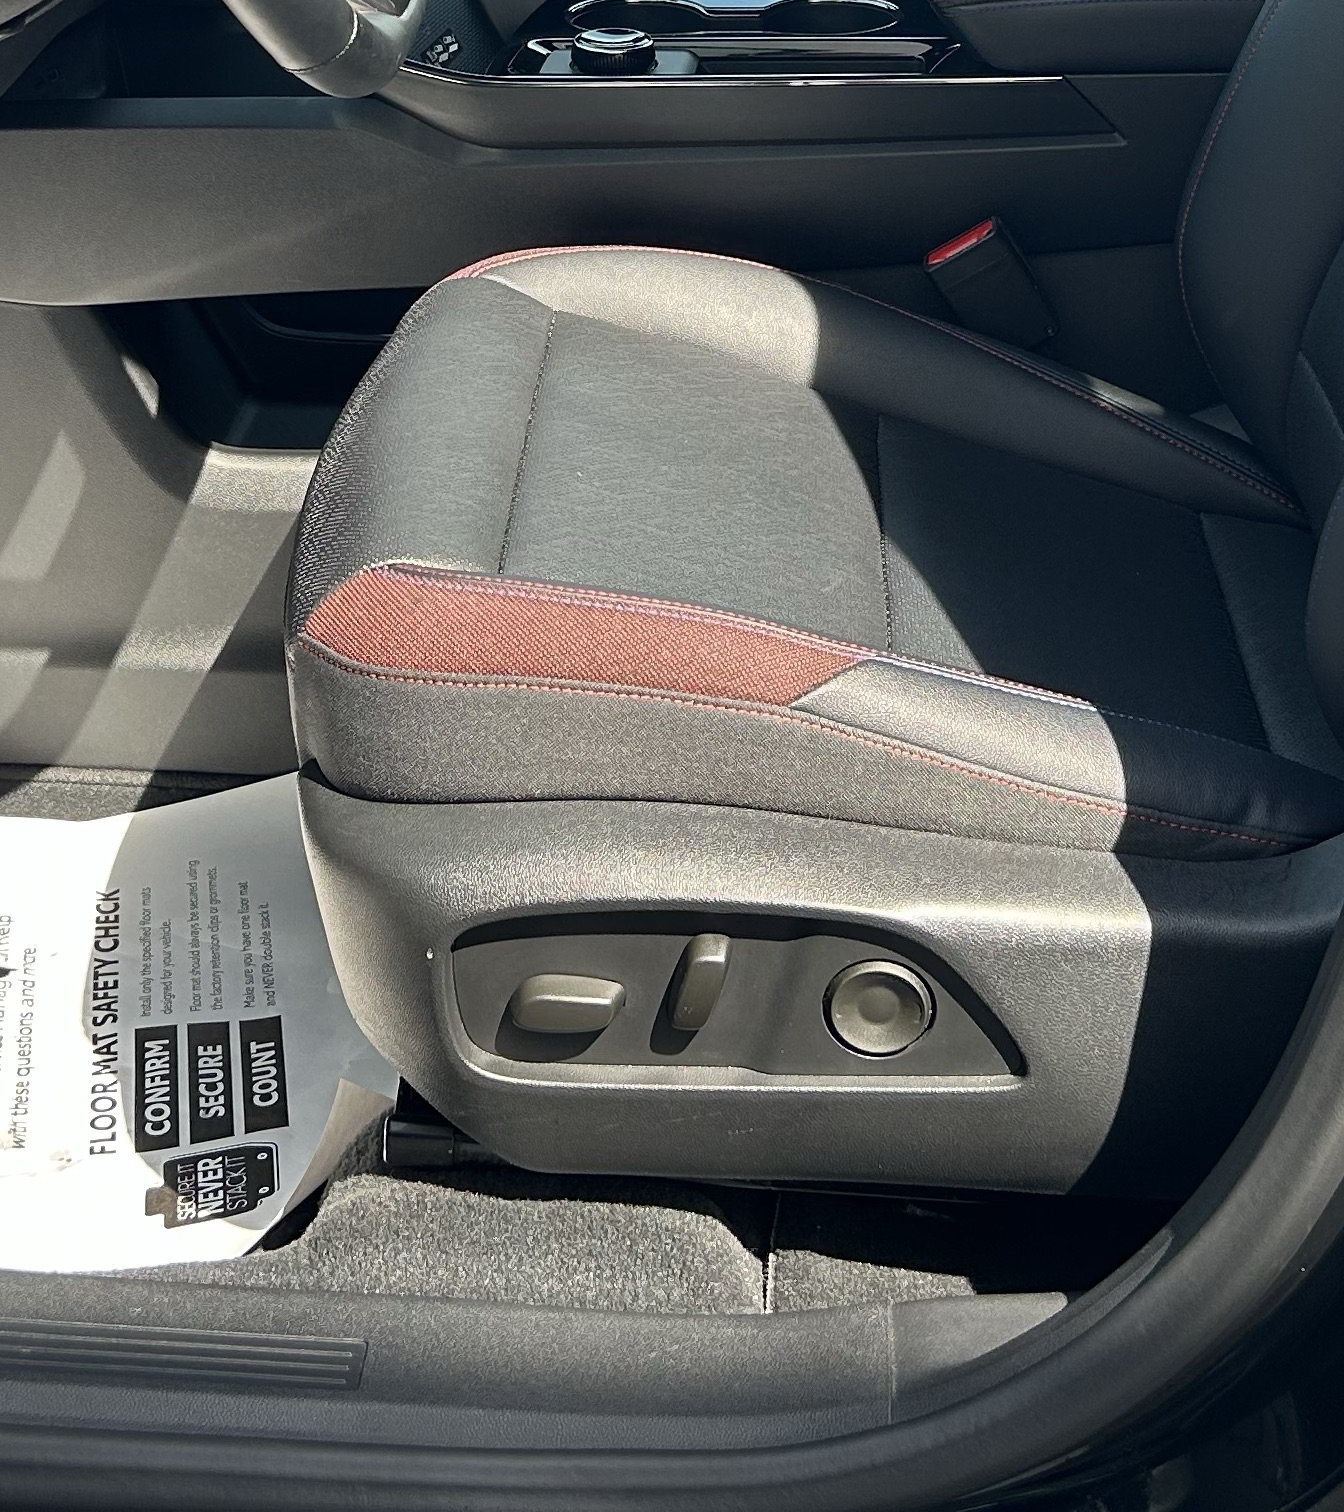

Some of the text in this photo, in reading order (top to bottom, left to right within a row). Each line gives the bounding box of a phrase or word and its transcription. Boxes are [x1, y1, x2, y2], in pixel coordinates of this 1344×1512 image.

[186, 882, 199, 909] secured
[186, 910, 199, 921] be
[207, 914, 221, 931] clips
[240, 914, 251, 929] one
[258, 909, 270, 929] stack
[140, 926, 154, 962] specified
[208, 933, 222, 968] retention
[239, 930, 252, 951] have
[259, 930, 273, 960] double
[140, 963, 152, 975] the
[160, 918, 175, 1014] designed for your vehicle.
[188, 950, 201, 976] should
[242, 952, 257, 967] you
[190, 977, 201, 990] mat
[209, 969, 225, 995] factory
[242, 968, 254, 984] sure
[261, 962, 275, 988] NEVER
[15, 977, 38, 1008] and
[139, 994, 152, 1016] Install
[189, 992, 202, 1011] Floor
[210, 996, 223, 1010] the
[242, 985, 256, 1007] Make
[263, 990, 276, 1006] and
[89, 887, 120, 1155] FLOOR MAT SAFETY CHECK
[9, 1010, 41, 1078] questions
[197, 1043, 225, 1118] SECURE
[250, 1040, 279, 1107] COUNT
[8, 1079, 32, 1116] these
[143, 1038, 172, 1136] CONFIRM
[173, 1162, 199, 1220] SECURE IT
[192, 1155, 227, 1218] NEVER
[223, 1154, 249, 1210] STACK IT
